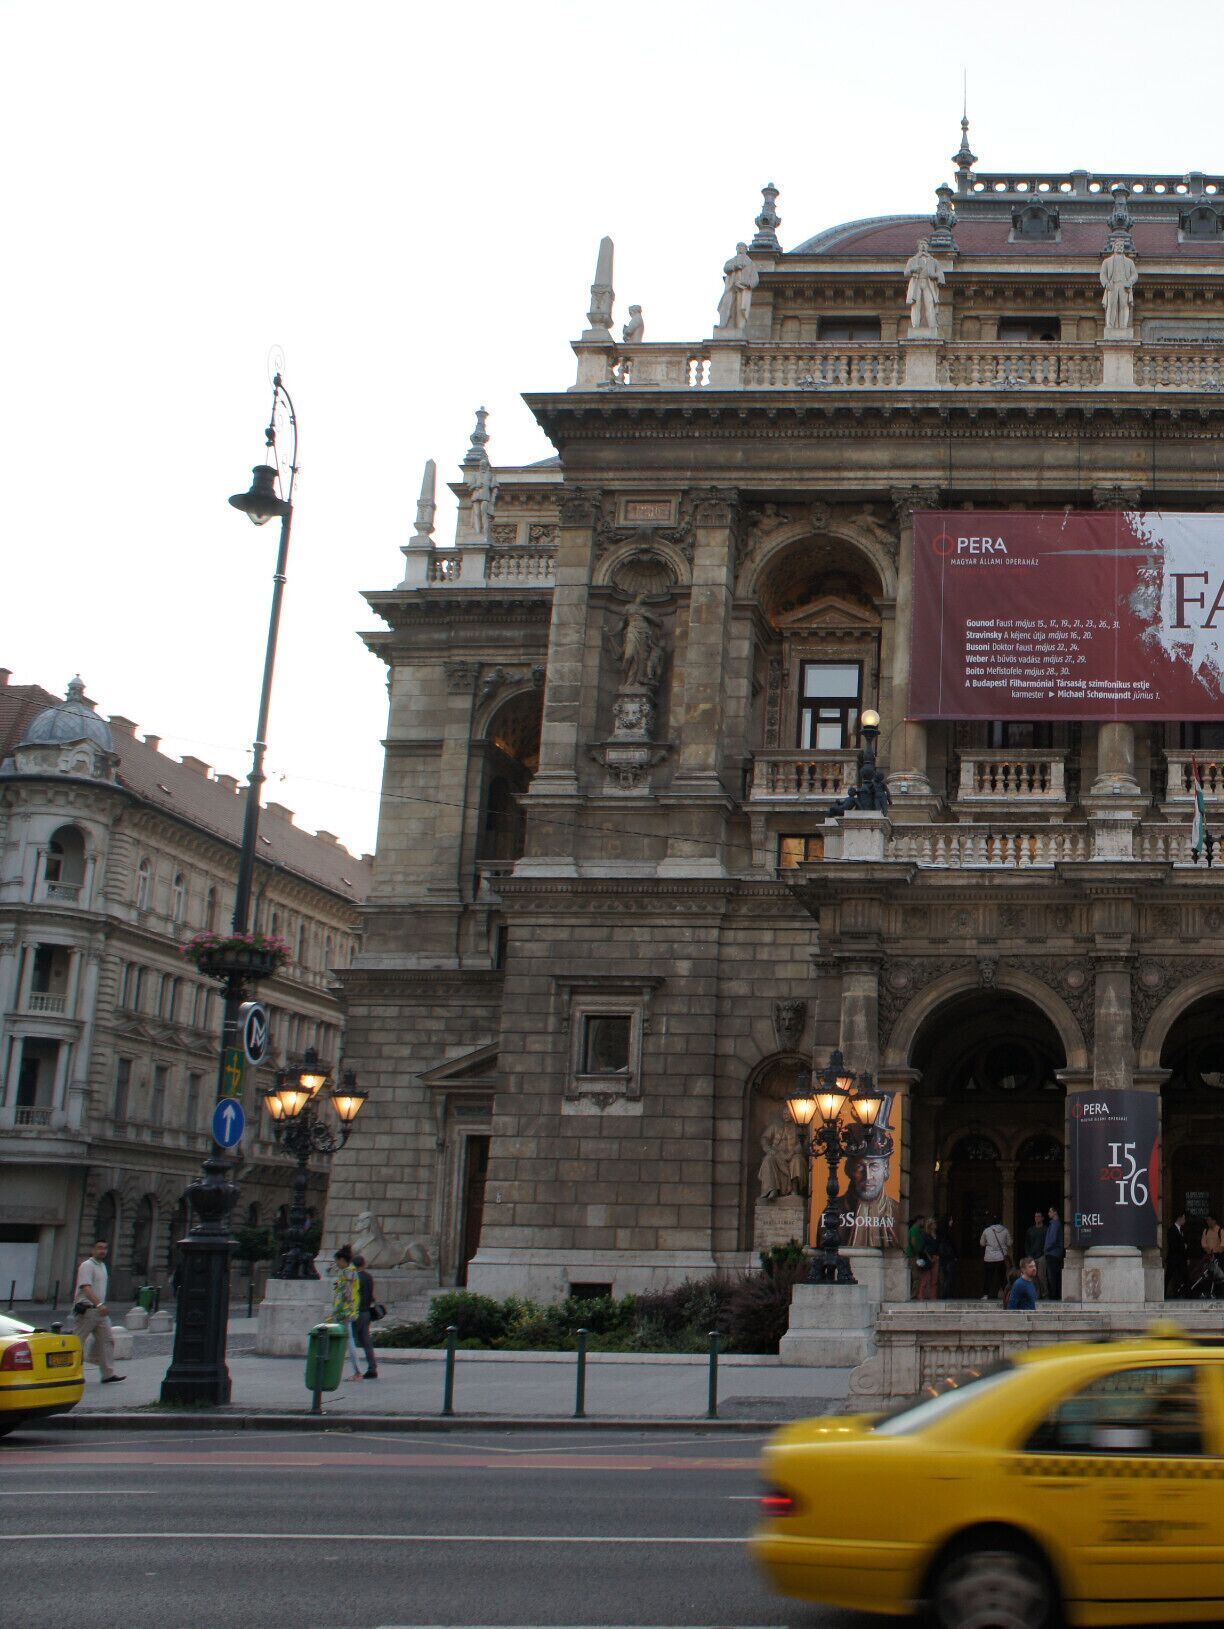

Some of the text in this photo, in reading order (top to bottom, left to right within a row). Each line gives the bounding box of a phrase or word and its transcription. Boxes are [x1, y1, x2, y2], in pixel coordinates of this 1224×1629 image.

[932, 533, 1008, 556] OPERA
[950, 558, 977, 566] MAGYAR
[1006, 558, 1039, 566] OPERAHÁZ
[966, 619, 1120, 629] Gounod Faust május 15., 17., 19., 21., 23., 26., 31.
[966, 631, 1002, 640] Stravinsky
[1010, 631, 1031, 640] kéjenc
[1033, 632, 1045, 641] útja
[1048, 632, 1069, 640] május
[1070, 632, 1080, 640] 16.,
[966, 643, 990, 651] Busoni
[992, 643, 1014, 651] Doktor
[1016, 643, 1033, 651] Faust
[1035, 643, 1055, 652] május
[1057, 643, 1067, 652] 22.,
[965, 655, 989, 663] Weber
[990, 655, 996, 663] A
[1018, 655, 1041, 663] vadász
[1043, 655, 1063, 664] május
[1065, 656, 1075, 664] 27.,
[1077, 655, 1087, 663] 29.
[965, 667, 1070, 677] Boito Mefistofele május 28., 30.
[972, 679, 1008, 688] Budapesti
[1009, 679, 1054, 688] Filharmóniai
[1057, 679, 1086, 689] Társaság
[1089, 680, 1131, 689] szimfonikus
[1133, 680, 1150, 690] estje
[1011, 690, 1044, 698] karmester
[1058, 690, 1085, 698] Michael
[1087, 690, 1131, 699] Schønwandt
[1132, 691, 1154, 700] június
[1072, 1102, 1110, 1119] OPERA
[1108, 1142, 1137, 1179] 15
[1115, 1168, 1148, 1206] 16
[1074, 1213, 1104, 1227] ERKEL
